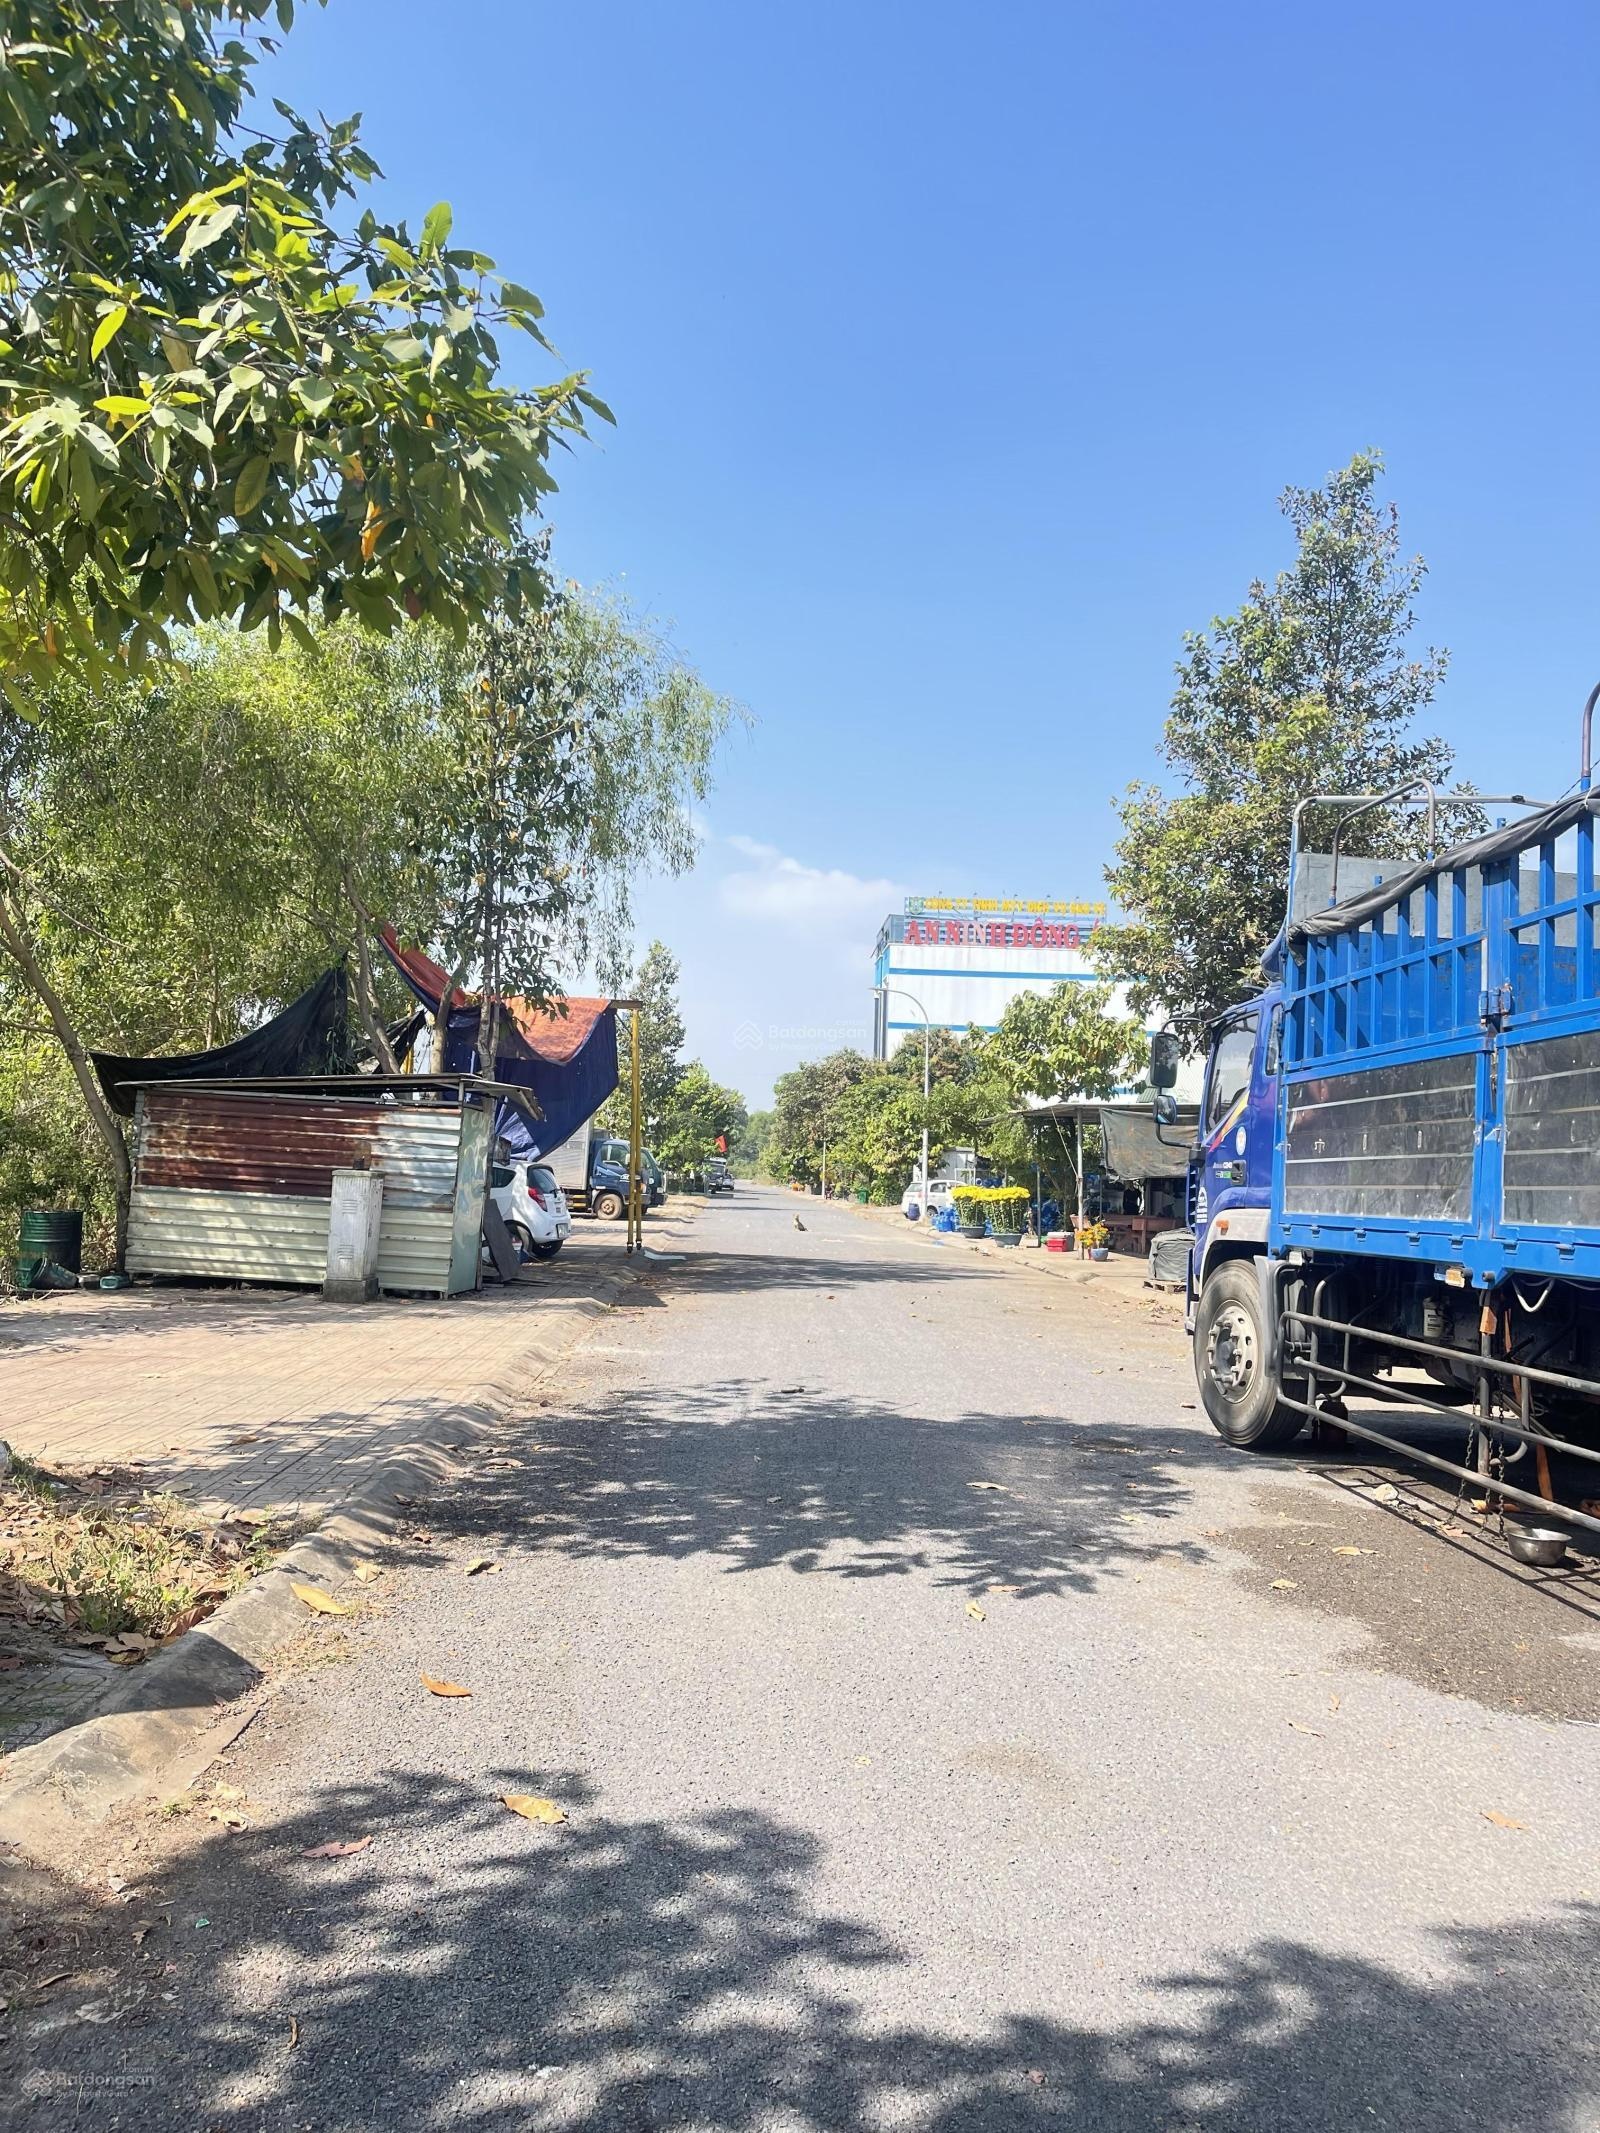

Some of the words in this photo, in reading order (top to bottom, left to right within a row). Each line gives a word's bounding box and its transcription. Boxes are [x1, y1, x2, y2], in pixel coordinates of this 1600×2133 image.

[903, 920, 939, 945] AN
[945, 920, 1008, 948] NINH
[1011, 917, 1081, 948] ĐÔNG
